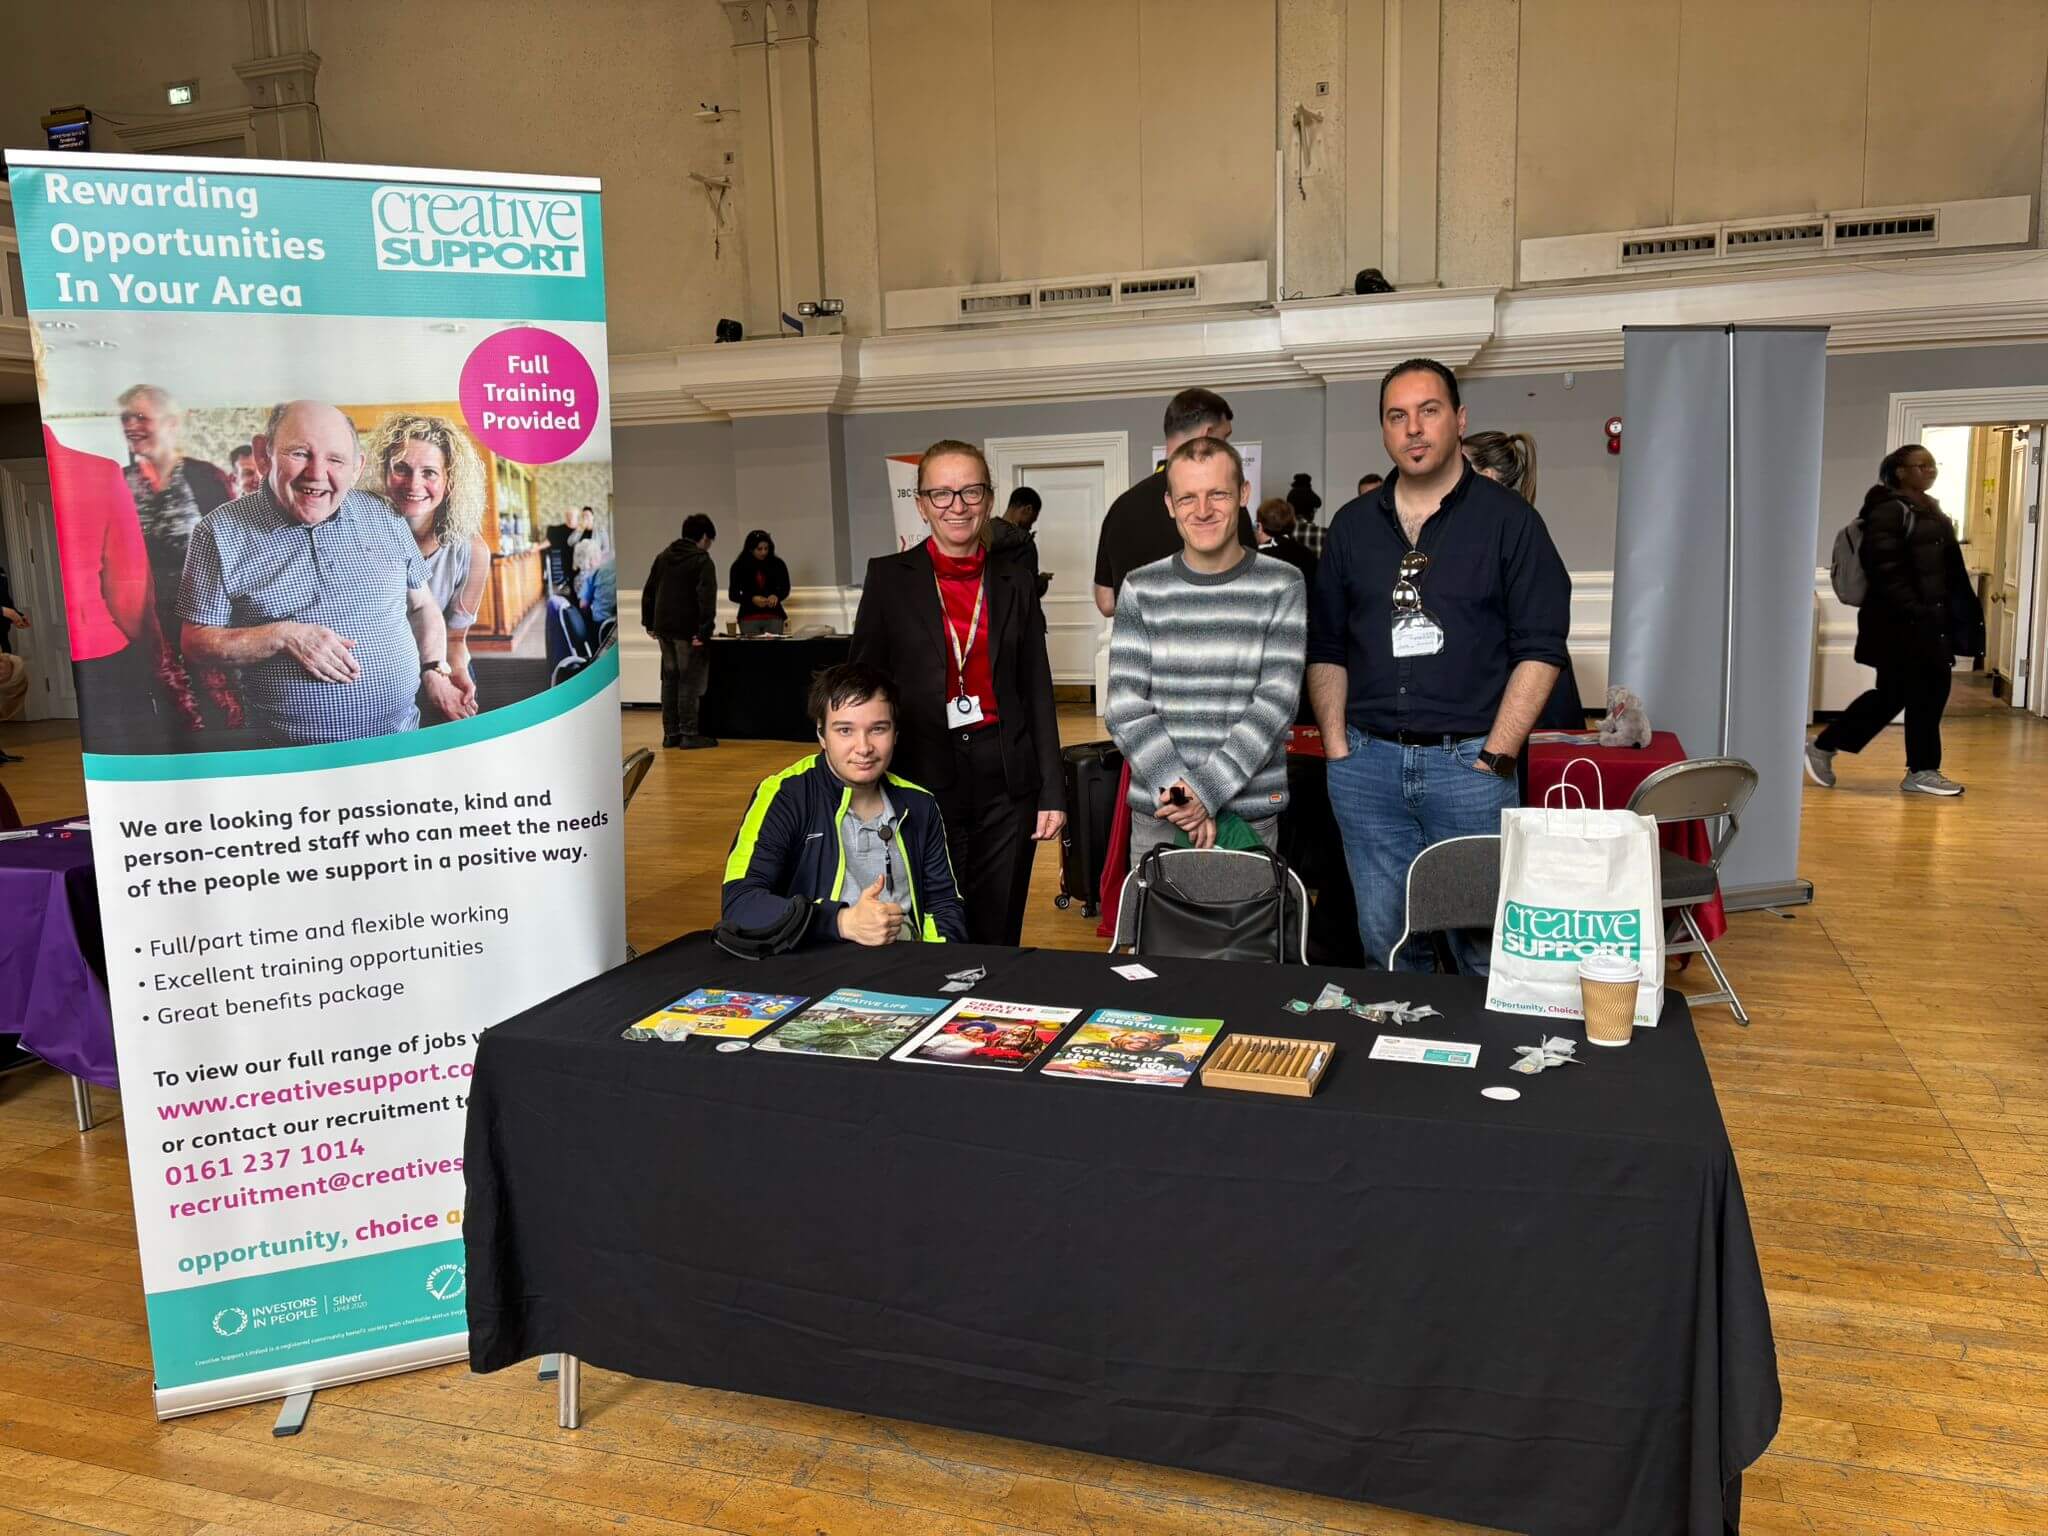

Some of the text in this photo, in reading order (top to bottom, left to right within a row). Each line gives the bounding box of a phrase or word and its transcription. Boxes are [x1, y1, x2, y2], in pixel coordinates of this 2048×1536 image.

[45, 173, 258, 218] Rewarding
[378, 189, 576, 241] creative
[51, 223, 325, 262] Opportunities
[383, 238, 579, 271] SUPPORT
[56, 273, 301, 306] In Your Area
[509, 356, 548, 373] Full
[484, 383, 574, 406] Training
[483, 412, 579, 429] Provided
[120, 790, 551, 838] We are looking for passionate, kind and
[125, 810, 608, 872] person-centred staff who can meet the needs
[128, 846, 587, 897] of the people we support in a positive way.
[151, 906, 508, 956] Full/part time and flexible working
[1505, 904, 1637, 940] creative
[1504, 932, 1637, 959] SUPPORT
[155, 940, 483, 990] Excellent training opportunities
[158, 983, 404, 1024] Great benefits package
[830, 996, 880, 1007] CREATIVE
[964, 1005, 1013, 1014] PEOPLE
[968, 1000, 1034, 1012] CREATIVE
[1490, 998, 1579, 1015] Opportunity, Choice
[1096, 1016, 1205, 1033] CREATIVE LIFE
[153, 1071, 179, 1087] To
[186, 1064, 238, 1082] view
[246, 1059, 281, 1074] our
[288, 1049, 324, 1068] full
[332, 1044, 391, 1063] range
[399, 1035, 419, 1053] of
[424, 1032, 466, 1054] jobs
[1065, 1050, 1176, 1072] the Carnival
[1071, 1046, 1140, 1059] Colours
[157, 1062, 474, 1121] www.creativesupport.co
[162, 1139, 184, 1153] or
[192, 1123, 277, 1148] contact
[284, 1119, 319, 1134] our
[327, 1097, 450, 1128] recruitment
[165, 1137, 365, 1186] 0161 237 1014
[169, 1156, 464, 1218] recruitment@creatives
[178, 1230, 348, 1274] opportunity,
[356, 1214, 438, 1241] choice
[252, 1293, 362, 1317] INVESTORS Silver
[253, 1317, 266, 1329] IN
[271, 1308, 318, 1326] PEOPLE
